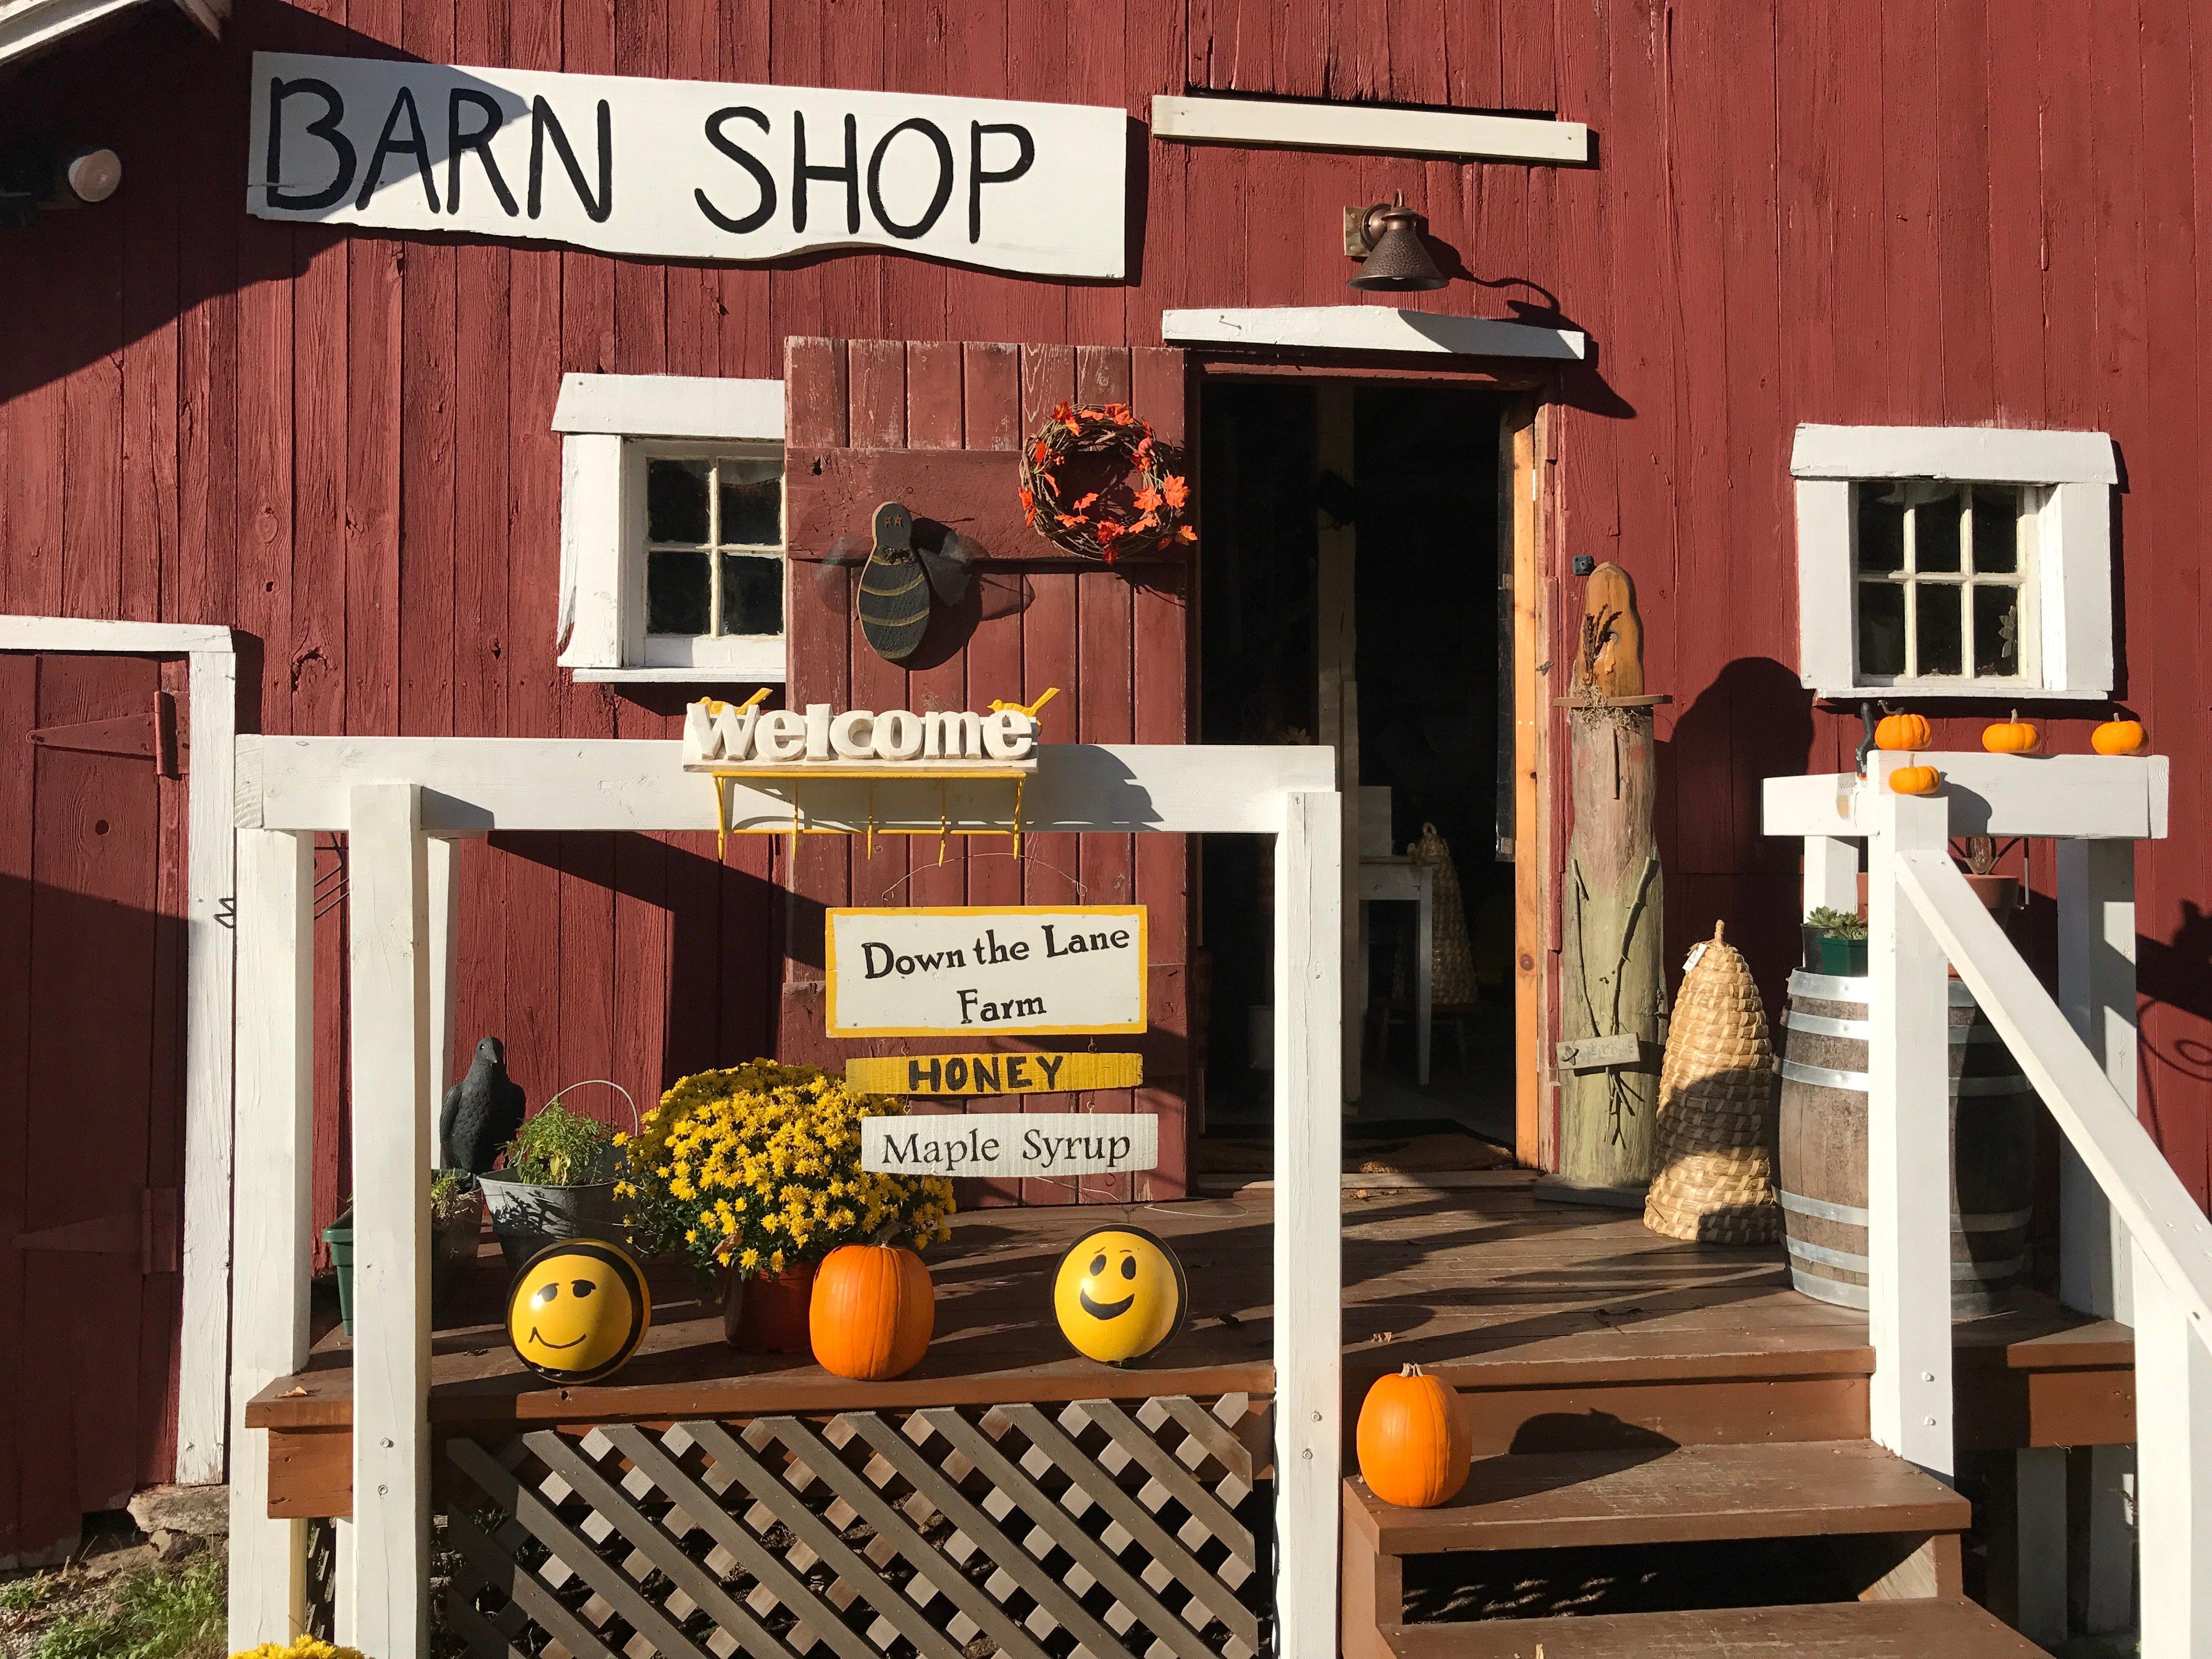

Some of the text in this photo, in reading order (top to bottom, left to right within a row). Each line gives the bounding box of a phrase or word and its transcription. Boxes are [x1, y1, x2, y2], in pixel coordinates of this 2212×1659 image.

[267, 76, 1035, 244] BARN SHOP
[686, 703, 1033, 761] Welcome
[861, 924, 1130, 979] Down the Lane
[956, 989, 1047, 1025] Farm
[908, 1055, 1063, 1092] HONEY
[882, 1128, 1130, 1171] Maple Syrup
